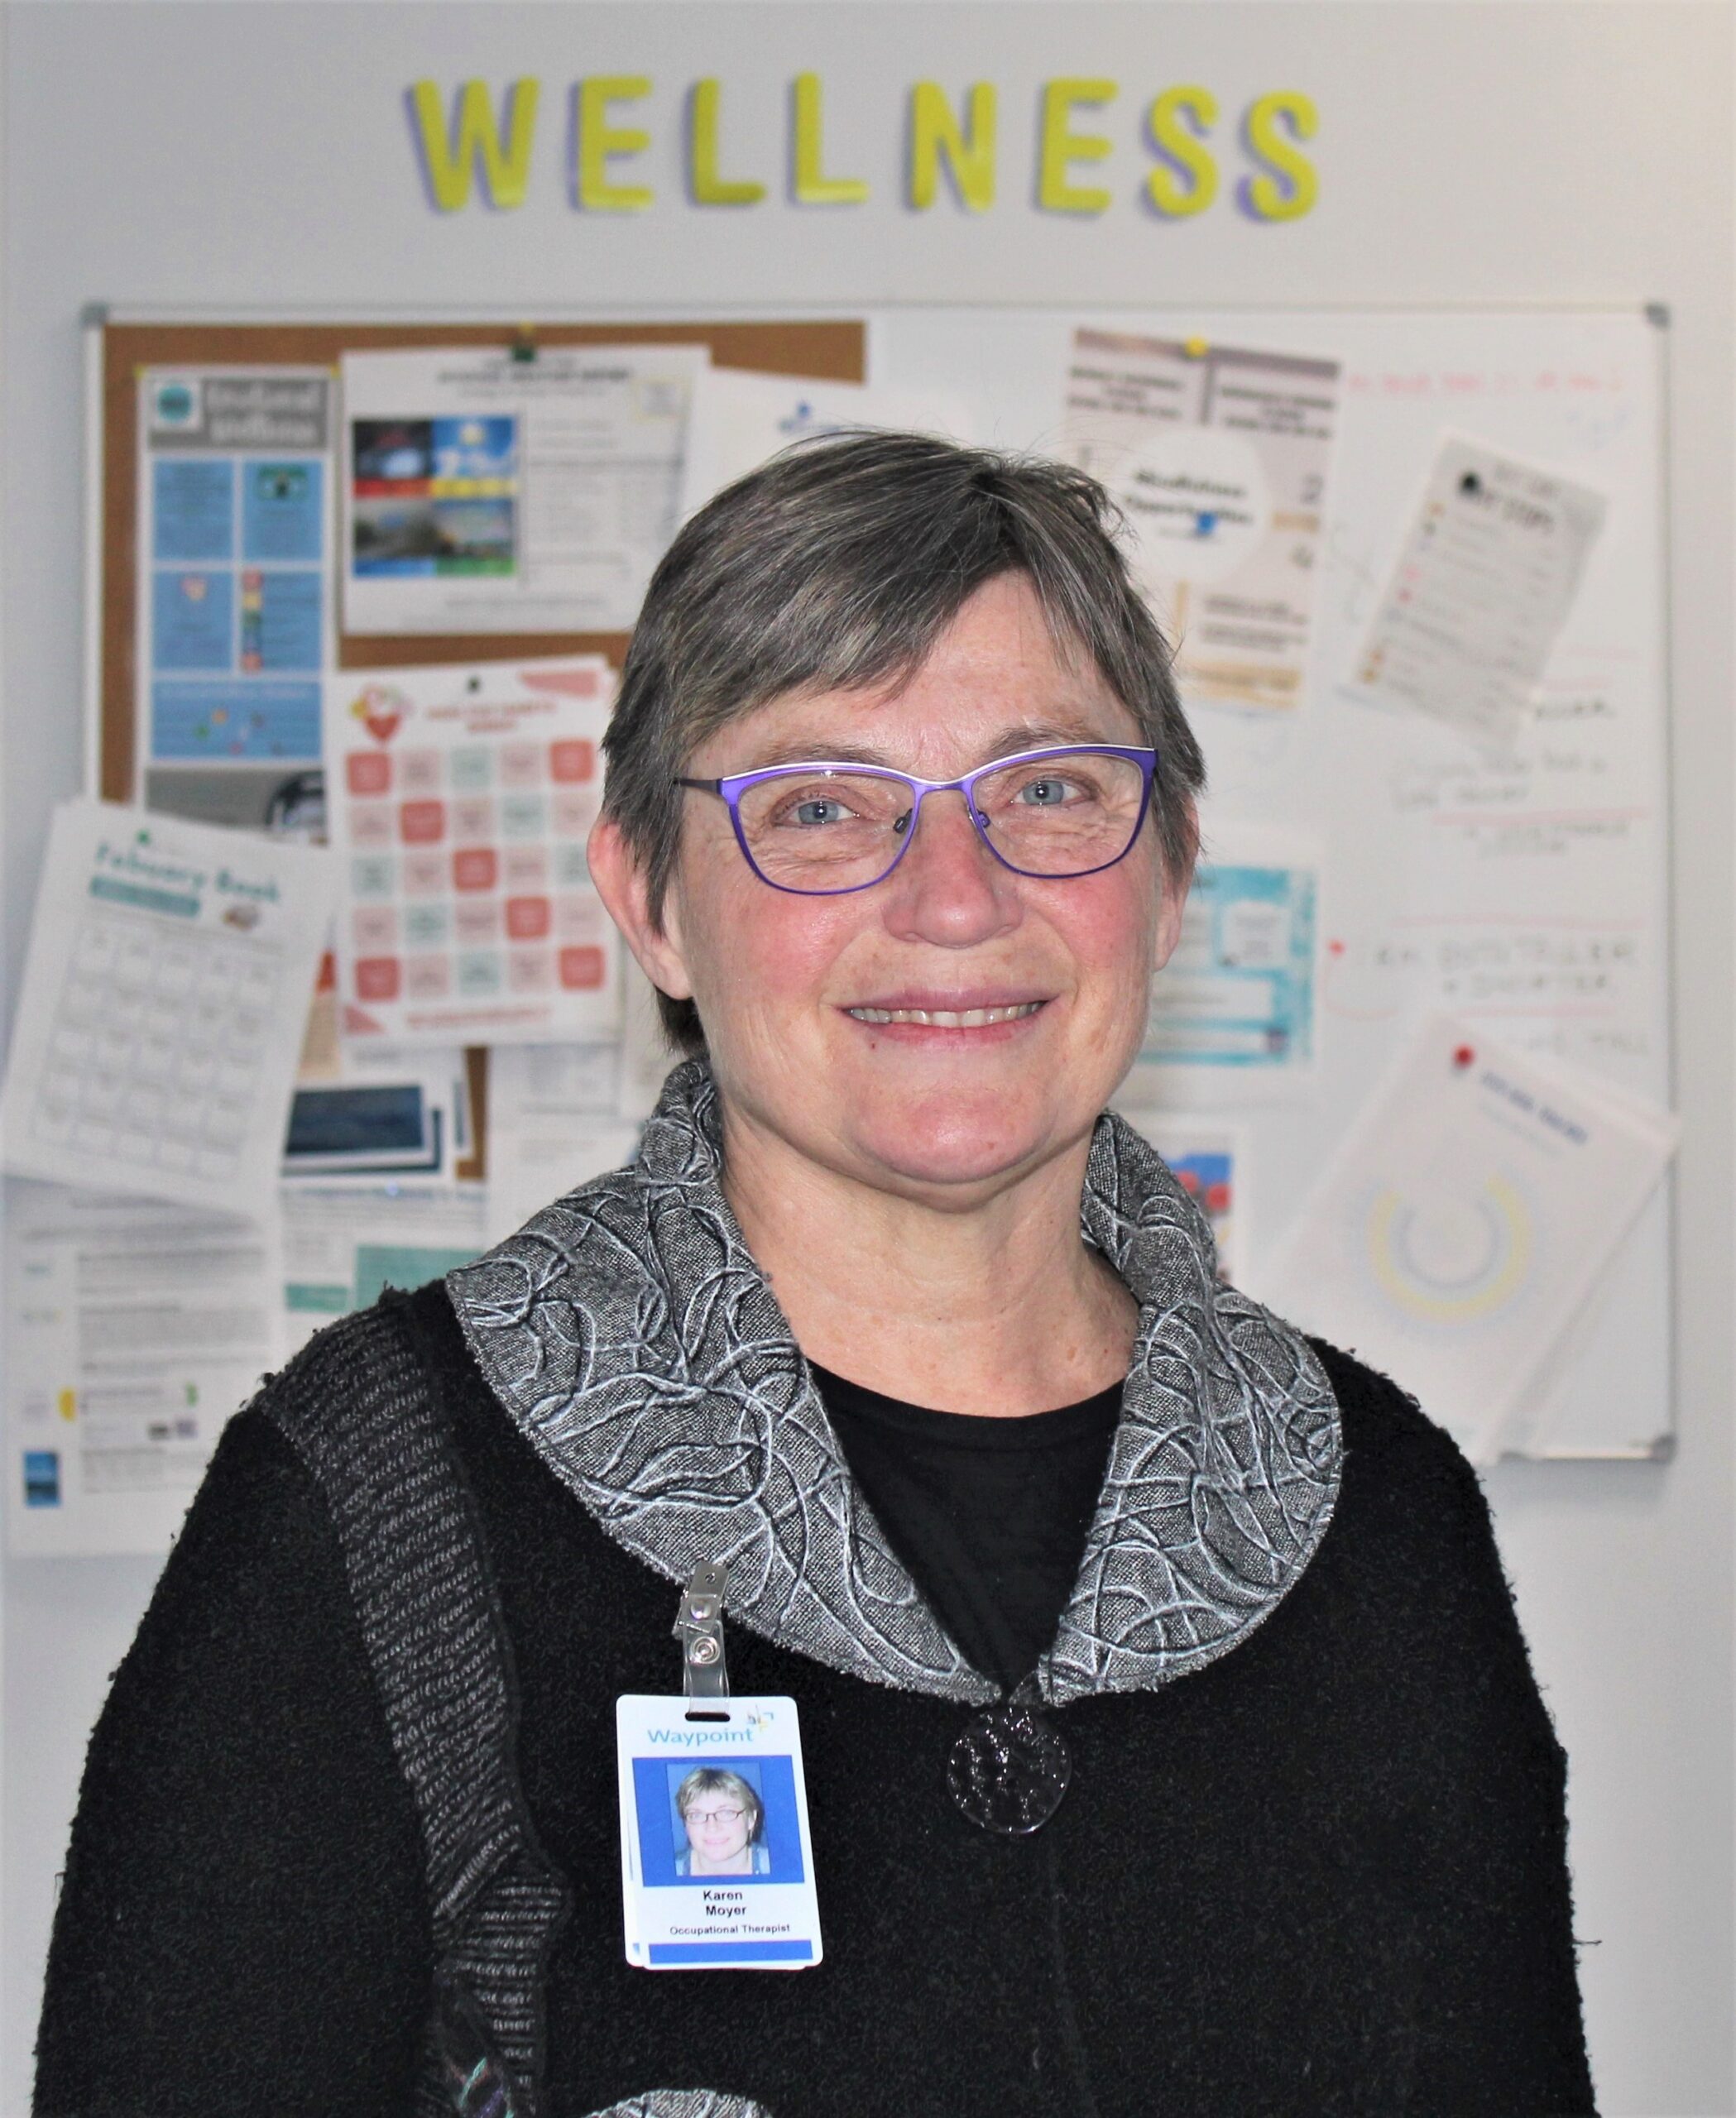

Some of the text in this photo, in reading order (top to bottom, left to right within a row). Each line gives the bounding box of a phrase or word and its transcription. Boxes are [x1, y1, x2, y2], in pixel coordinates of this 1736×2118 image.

[410, 71, 1320, 221] WELLNESS
[647, 1727, 754, 1747] Waypoint
[703, 1890, 743, 1901] Karen
[706, 1905, 747, 1918] Moyer
[669, 1923, 791, 1937] Occupational Therapist
